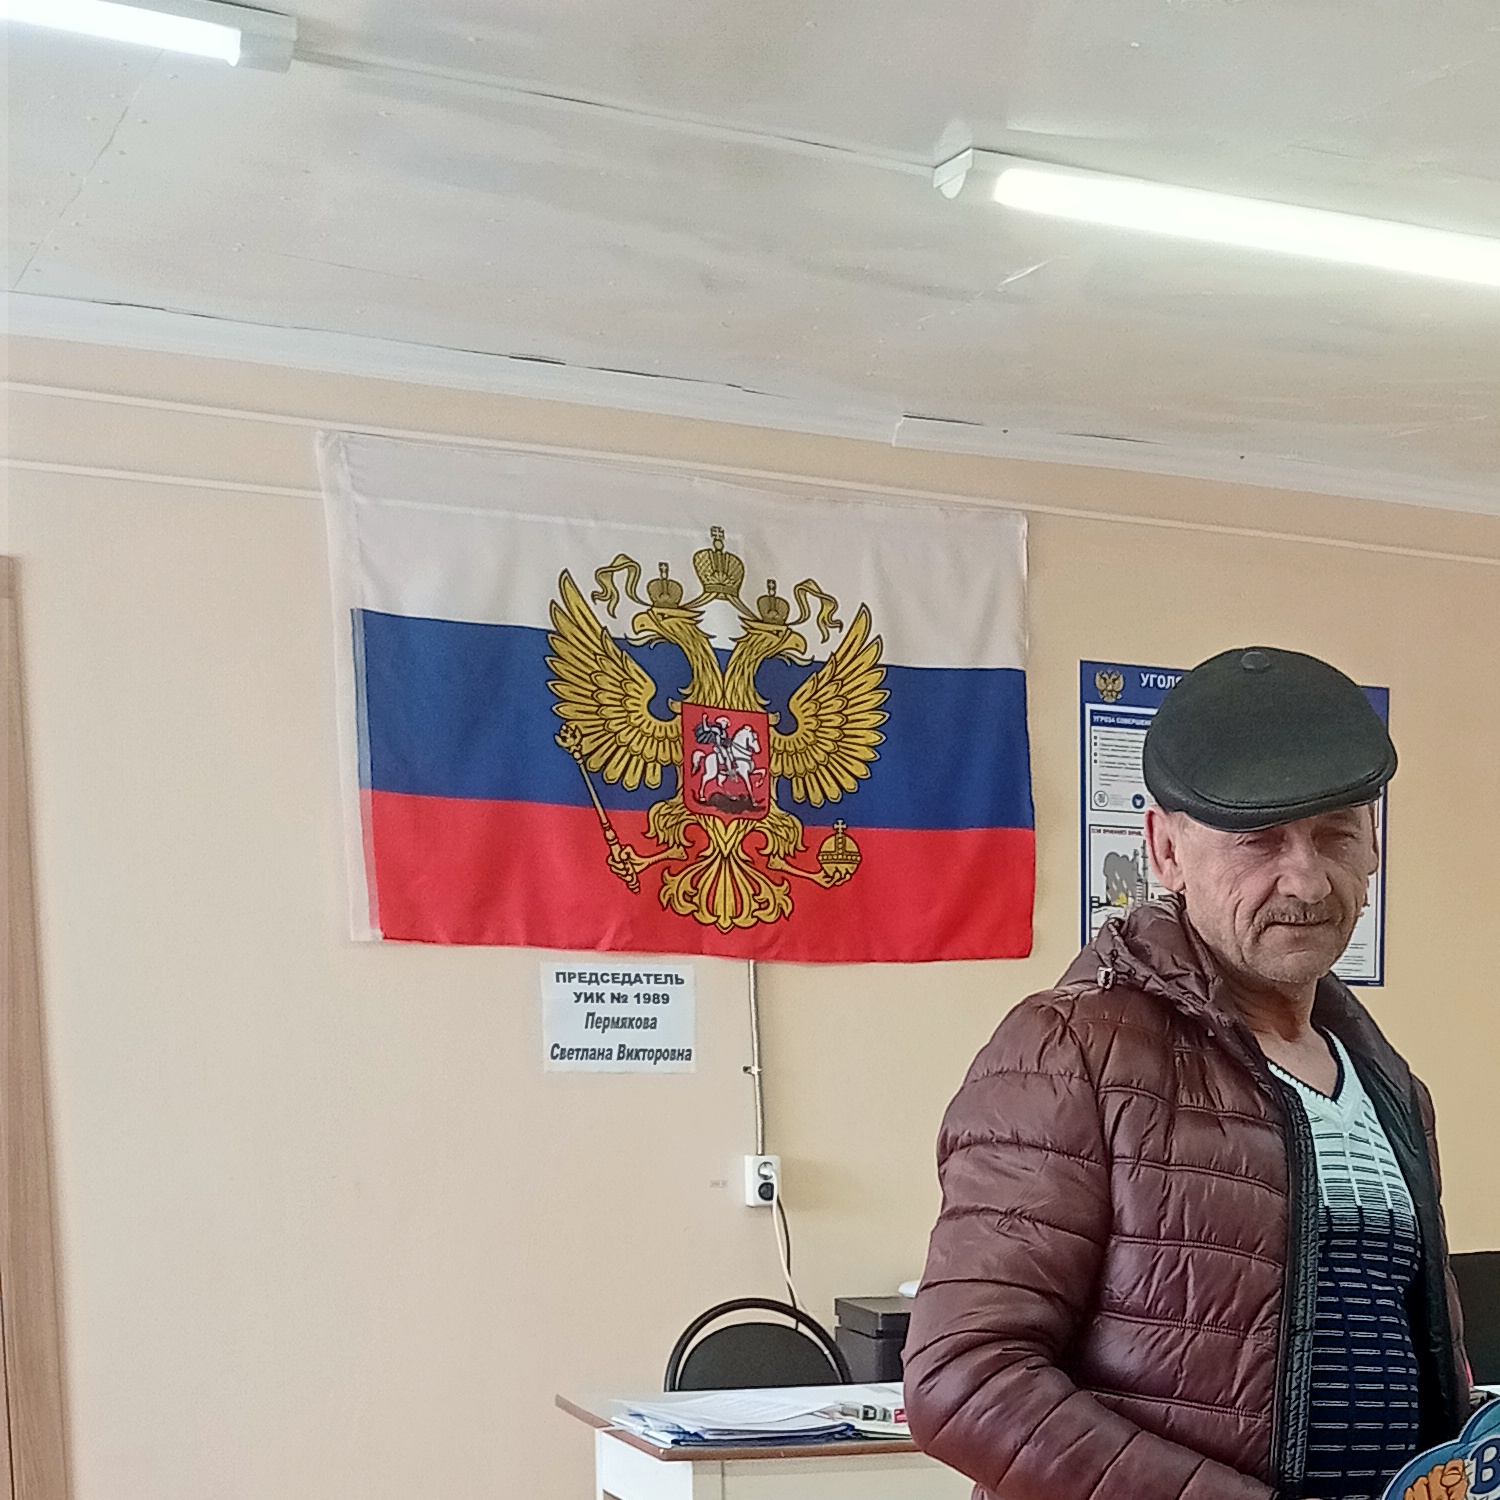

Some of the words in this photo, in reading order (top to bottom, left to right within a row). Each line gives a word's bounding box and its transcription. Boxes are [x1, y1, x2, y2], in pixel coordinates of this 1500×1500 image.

[555, 971, 685, 986] ПРЕДСЕДАТЕЛЬ
[573, 991, 606, 1004] УИК
[610, 992, 629, 1004] №
[633, 992, 670, 1005] 1989
[584, 1011, 658, 1034] Пермякова
[550, 1043, 613, 1061] Светлана
[616, 1043, 693, 1066] Викторовна
